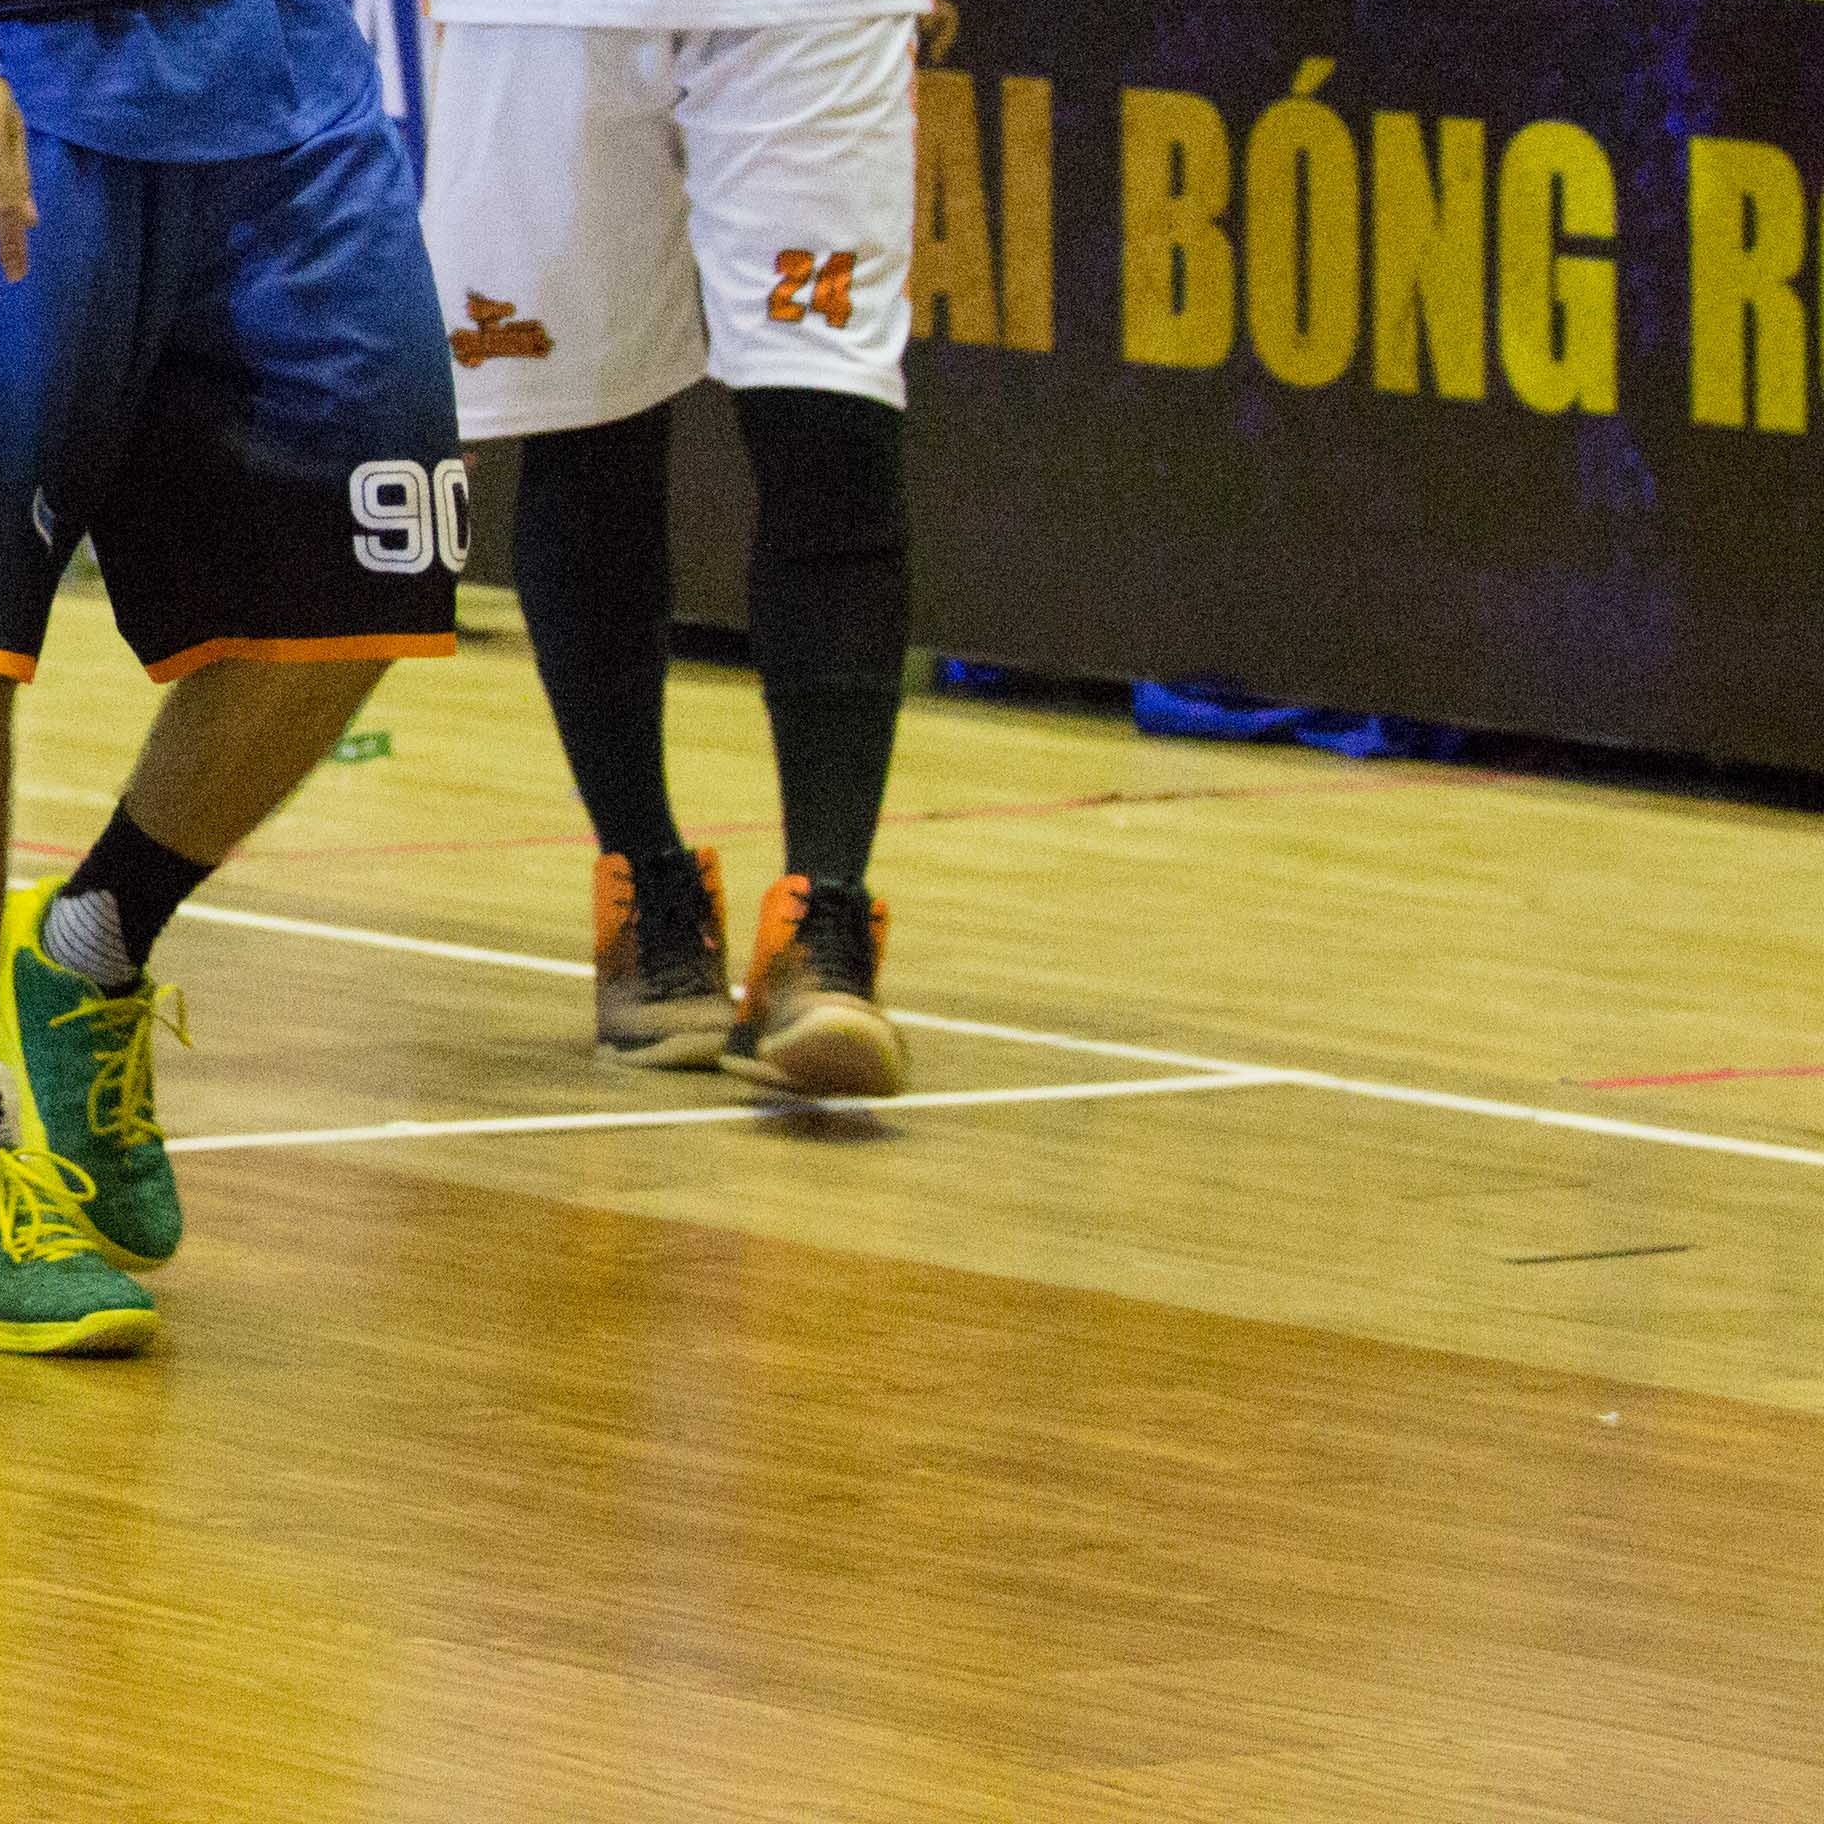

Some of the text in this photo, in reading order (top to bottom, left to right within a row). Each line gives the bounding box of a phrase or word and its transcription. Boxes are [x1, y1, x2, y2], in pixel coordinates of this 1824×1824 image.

[768, 249, 856, 329] 24
[1121, 56, 1618, 417] BÓNG
[1687, 134, 1823, 435] R
[350, 459, 472, 574] 90
